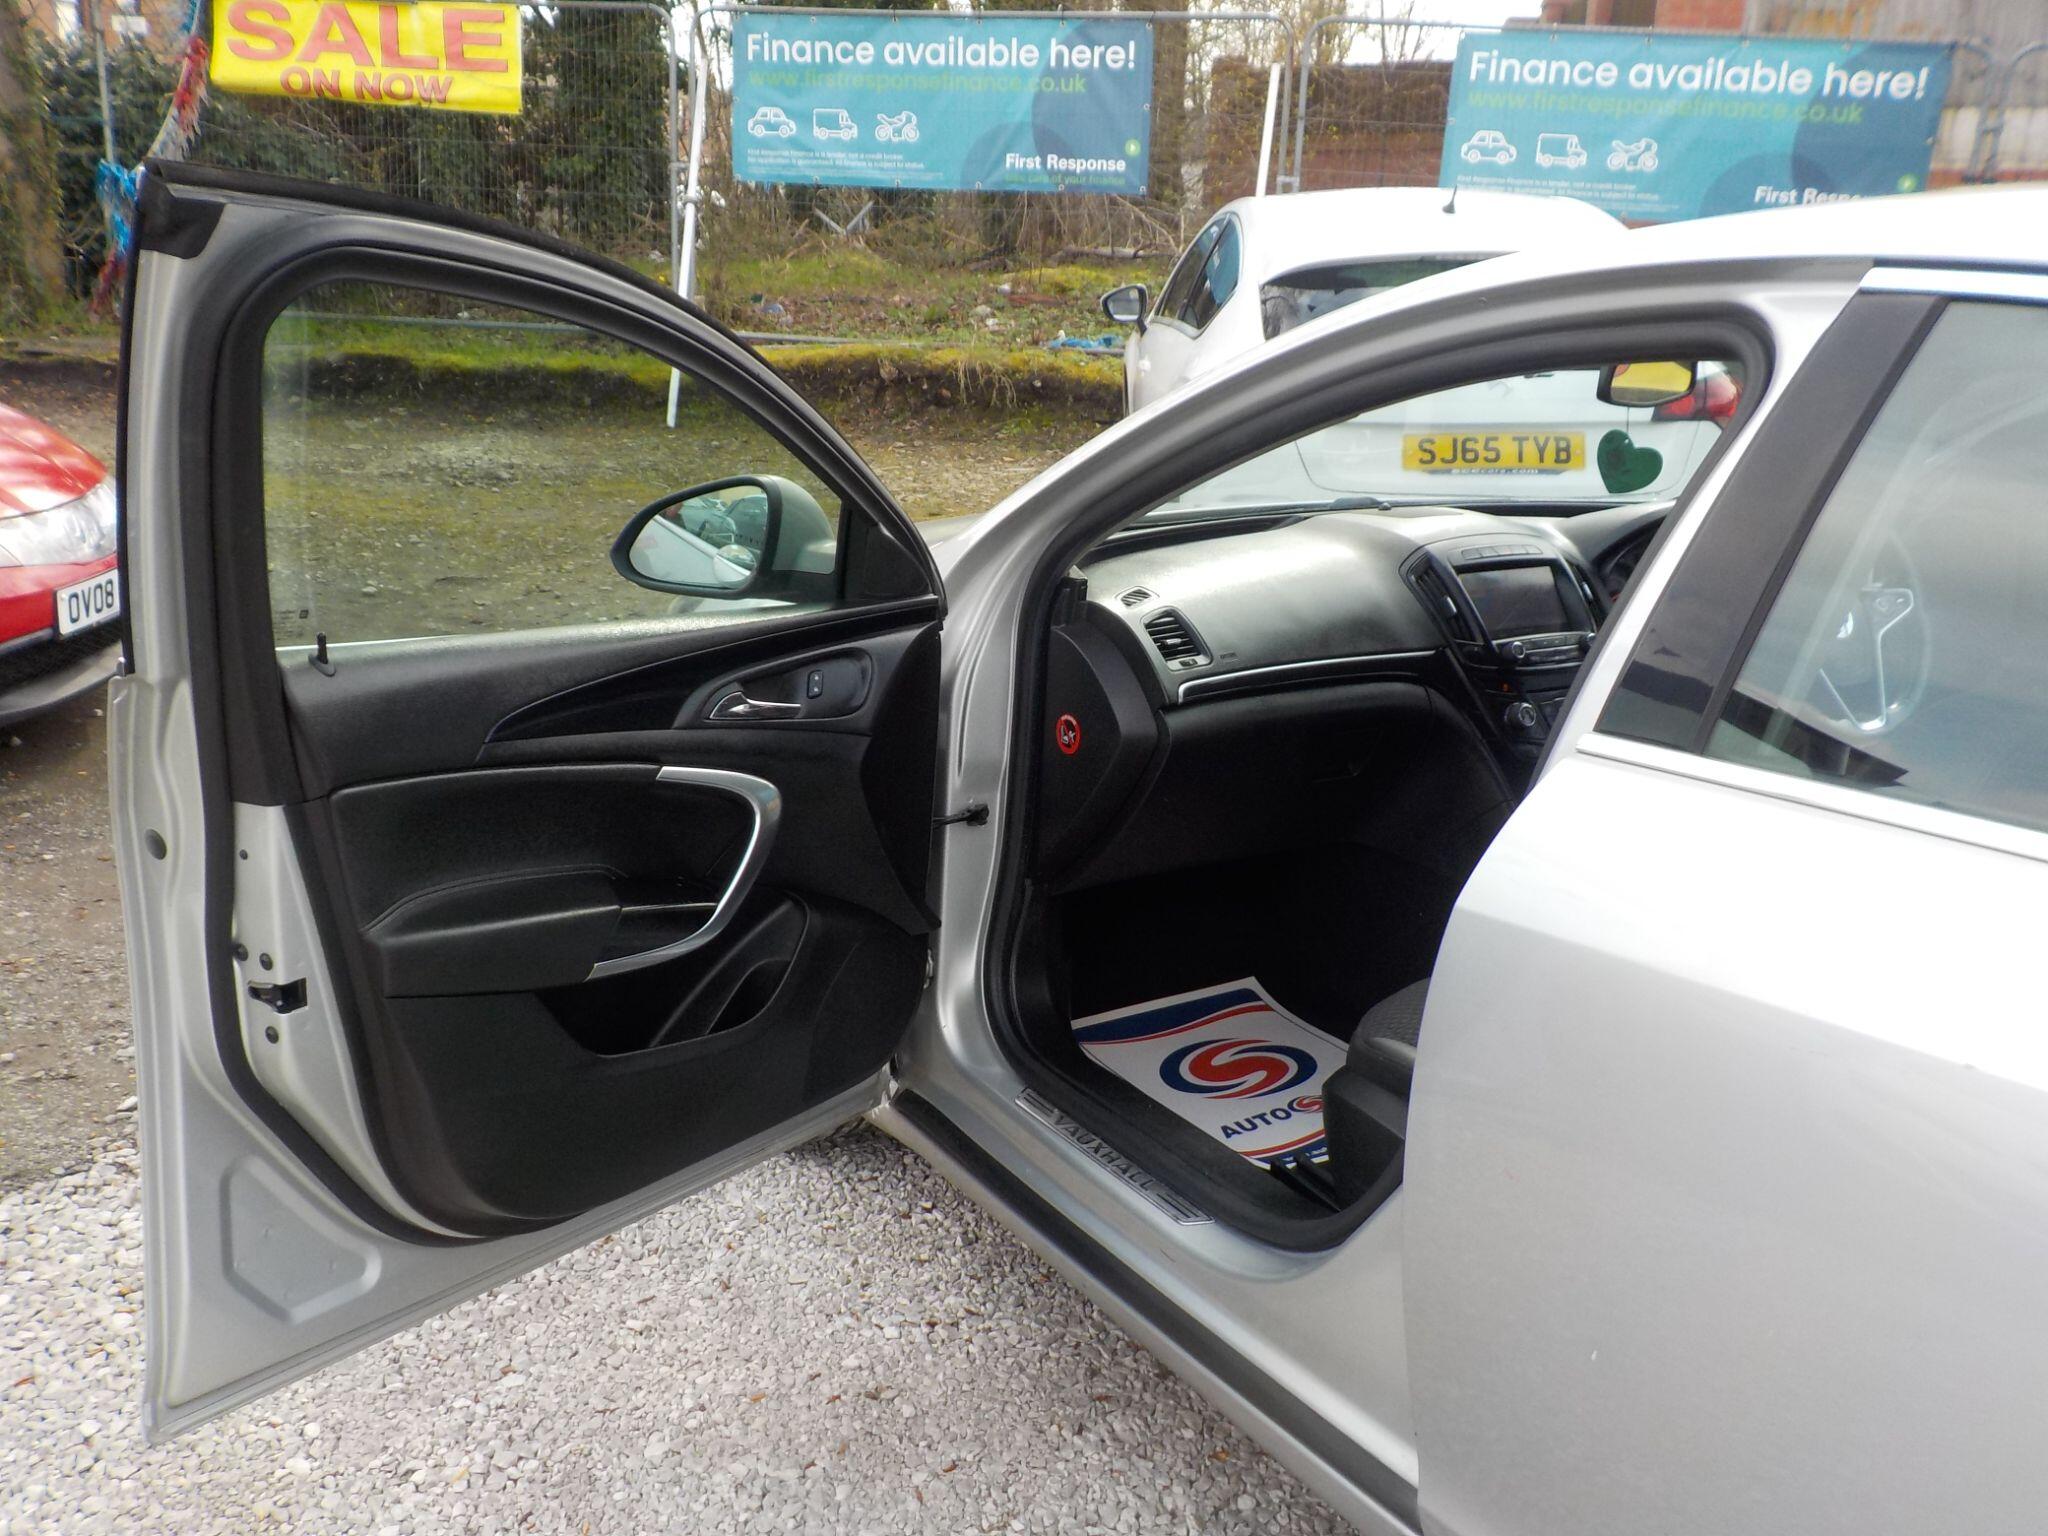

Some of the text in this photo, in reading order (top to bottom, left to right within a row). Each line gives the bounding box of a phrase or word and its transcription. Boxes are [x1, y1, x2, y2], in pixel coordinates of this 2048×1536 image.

[227, 0, 509, 73] SALE
[746, 32, 1137, 70] Finance available here!
[280, 66, 453, 104] ON NOW
[1468, 50, 1930, 101] Finance available here!
[1005, 153, 1127, 174] First Response
[1754, 185, 1798, 205] First
[1417, 435, 1573, 465] SJ65 TYB
[68, 578, 115, 624] OV08
[1052, 1111, 1156, 1191] VAUXHALL
